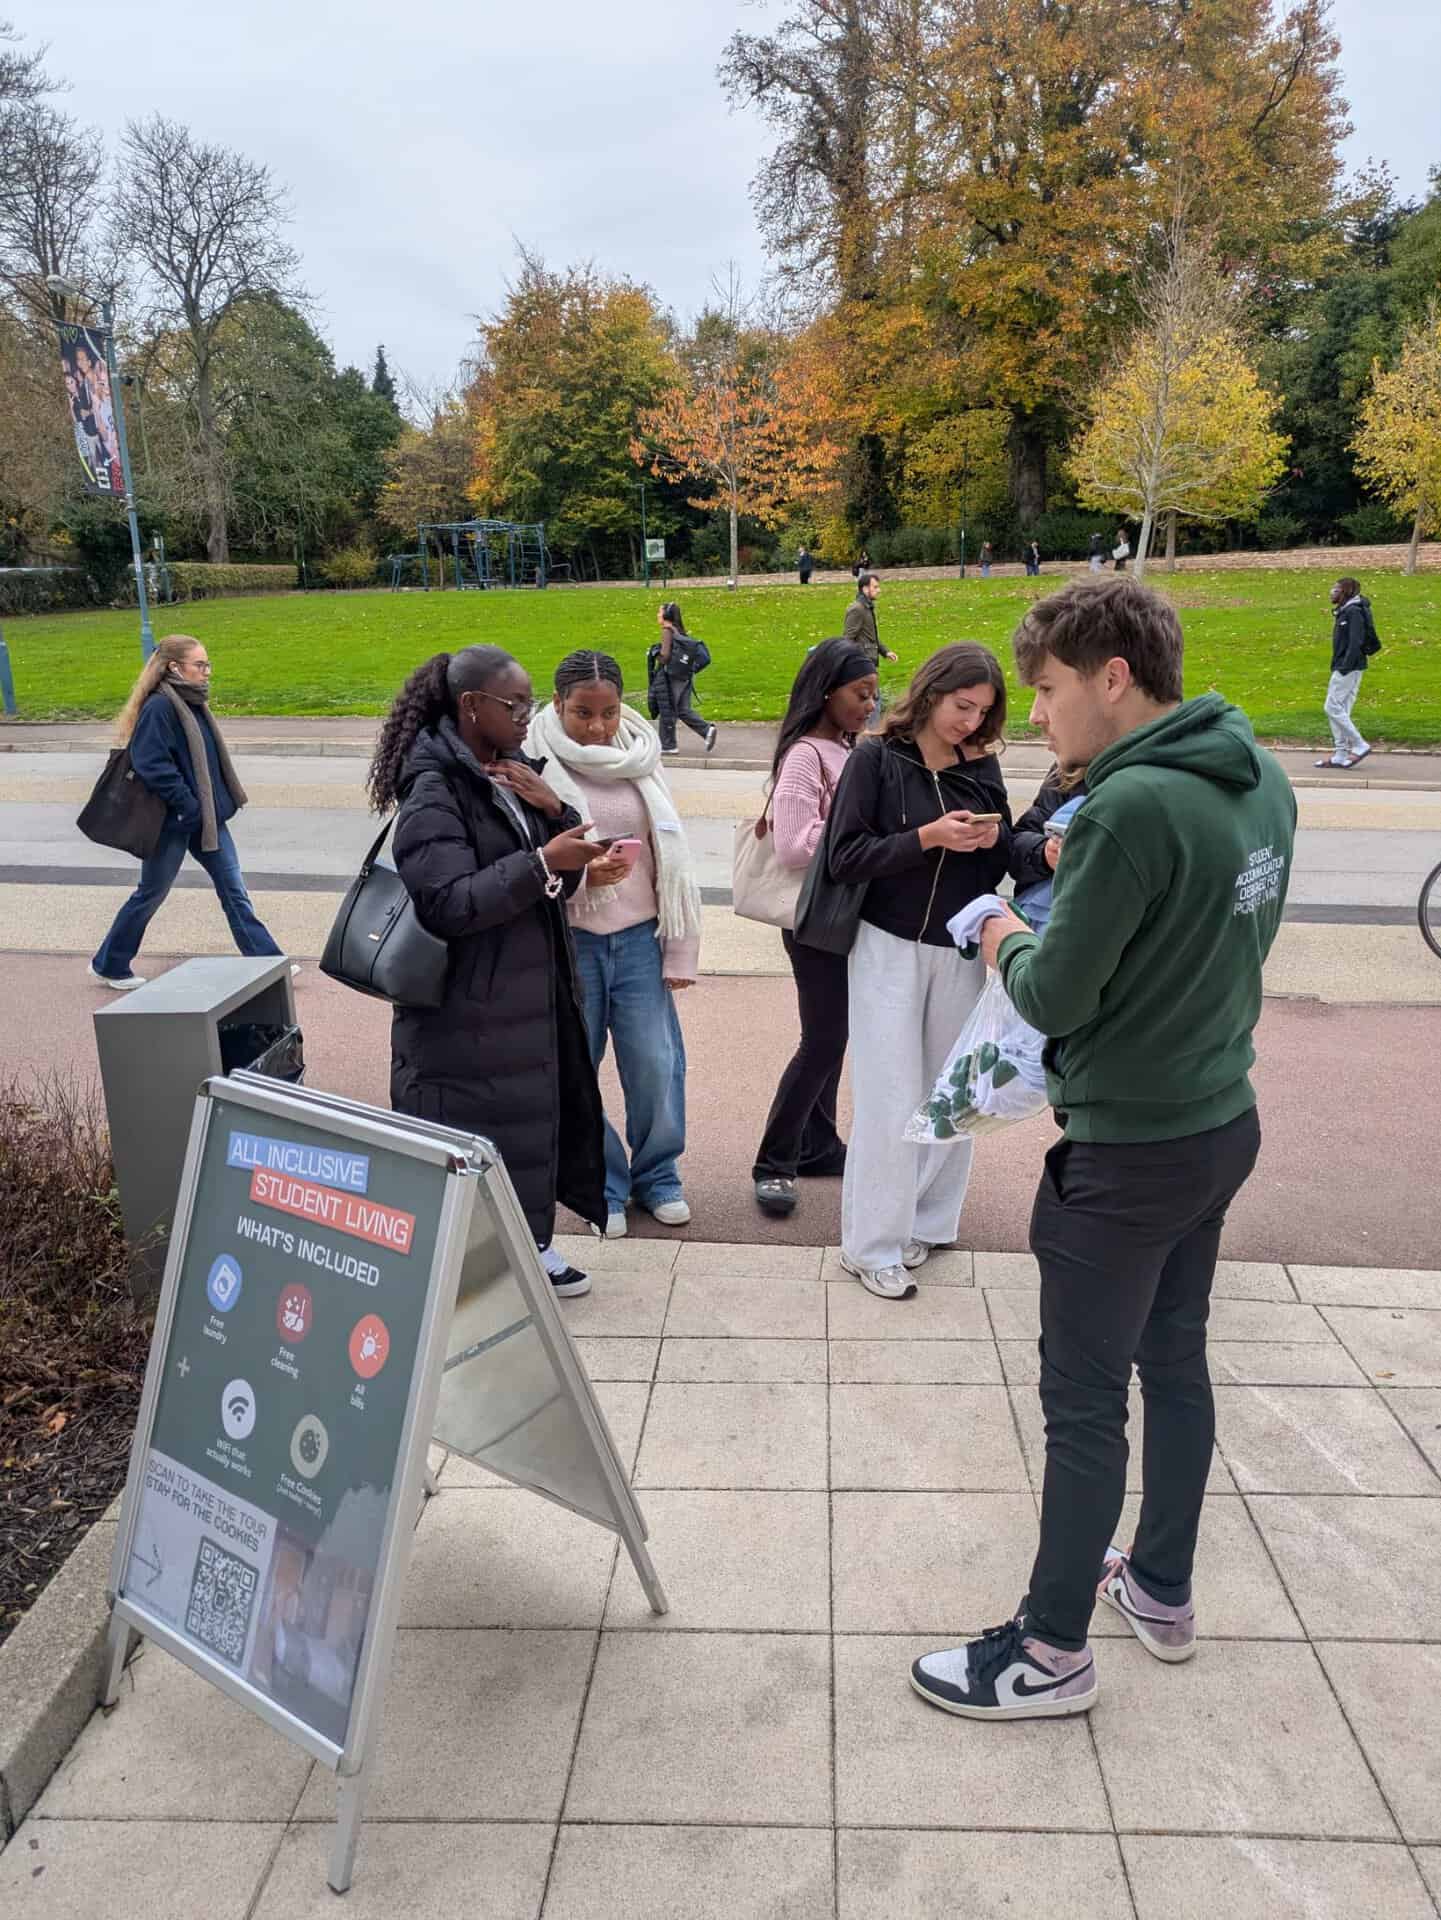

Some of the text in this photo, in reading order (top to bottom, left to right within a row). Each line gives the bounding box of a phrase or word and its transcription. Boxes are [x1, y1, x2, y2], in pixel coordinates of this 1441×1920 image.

[232, 1138, 365, 1186] ALL INCLUSIVE
[255, 1173, 409, 1245] STUDENT LIVING
[236, 1215, 380, 1286] WHAT'S INCLUDED
[210, 1315, 225, 1329] Free
[270, 1357, 299, 1380] cleaning
[279, 1346, 296, 1361] Free
[146, 1475, 259, 1552] STAY FOR THE COOKIES
[149, 1459, 267, 1537] SCAN TO TAKE THE TOUR
